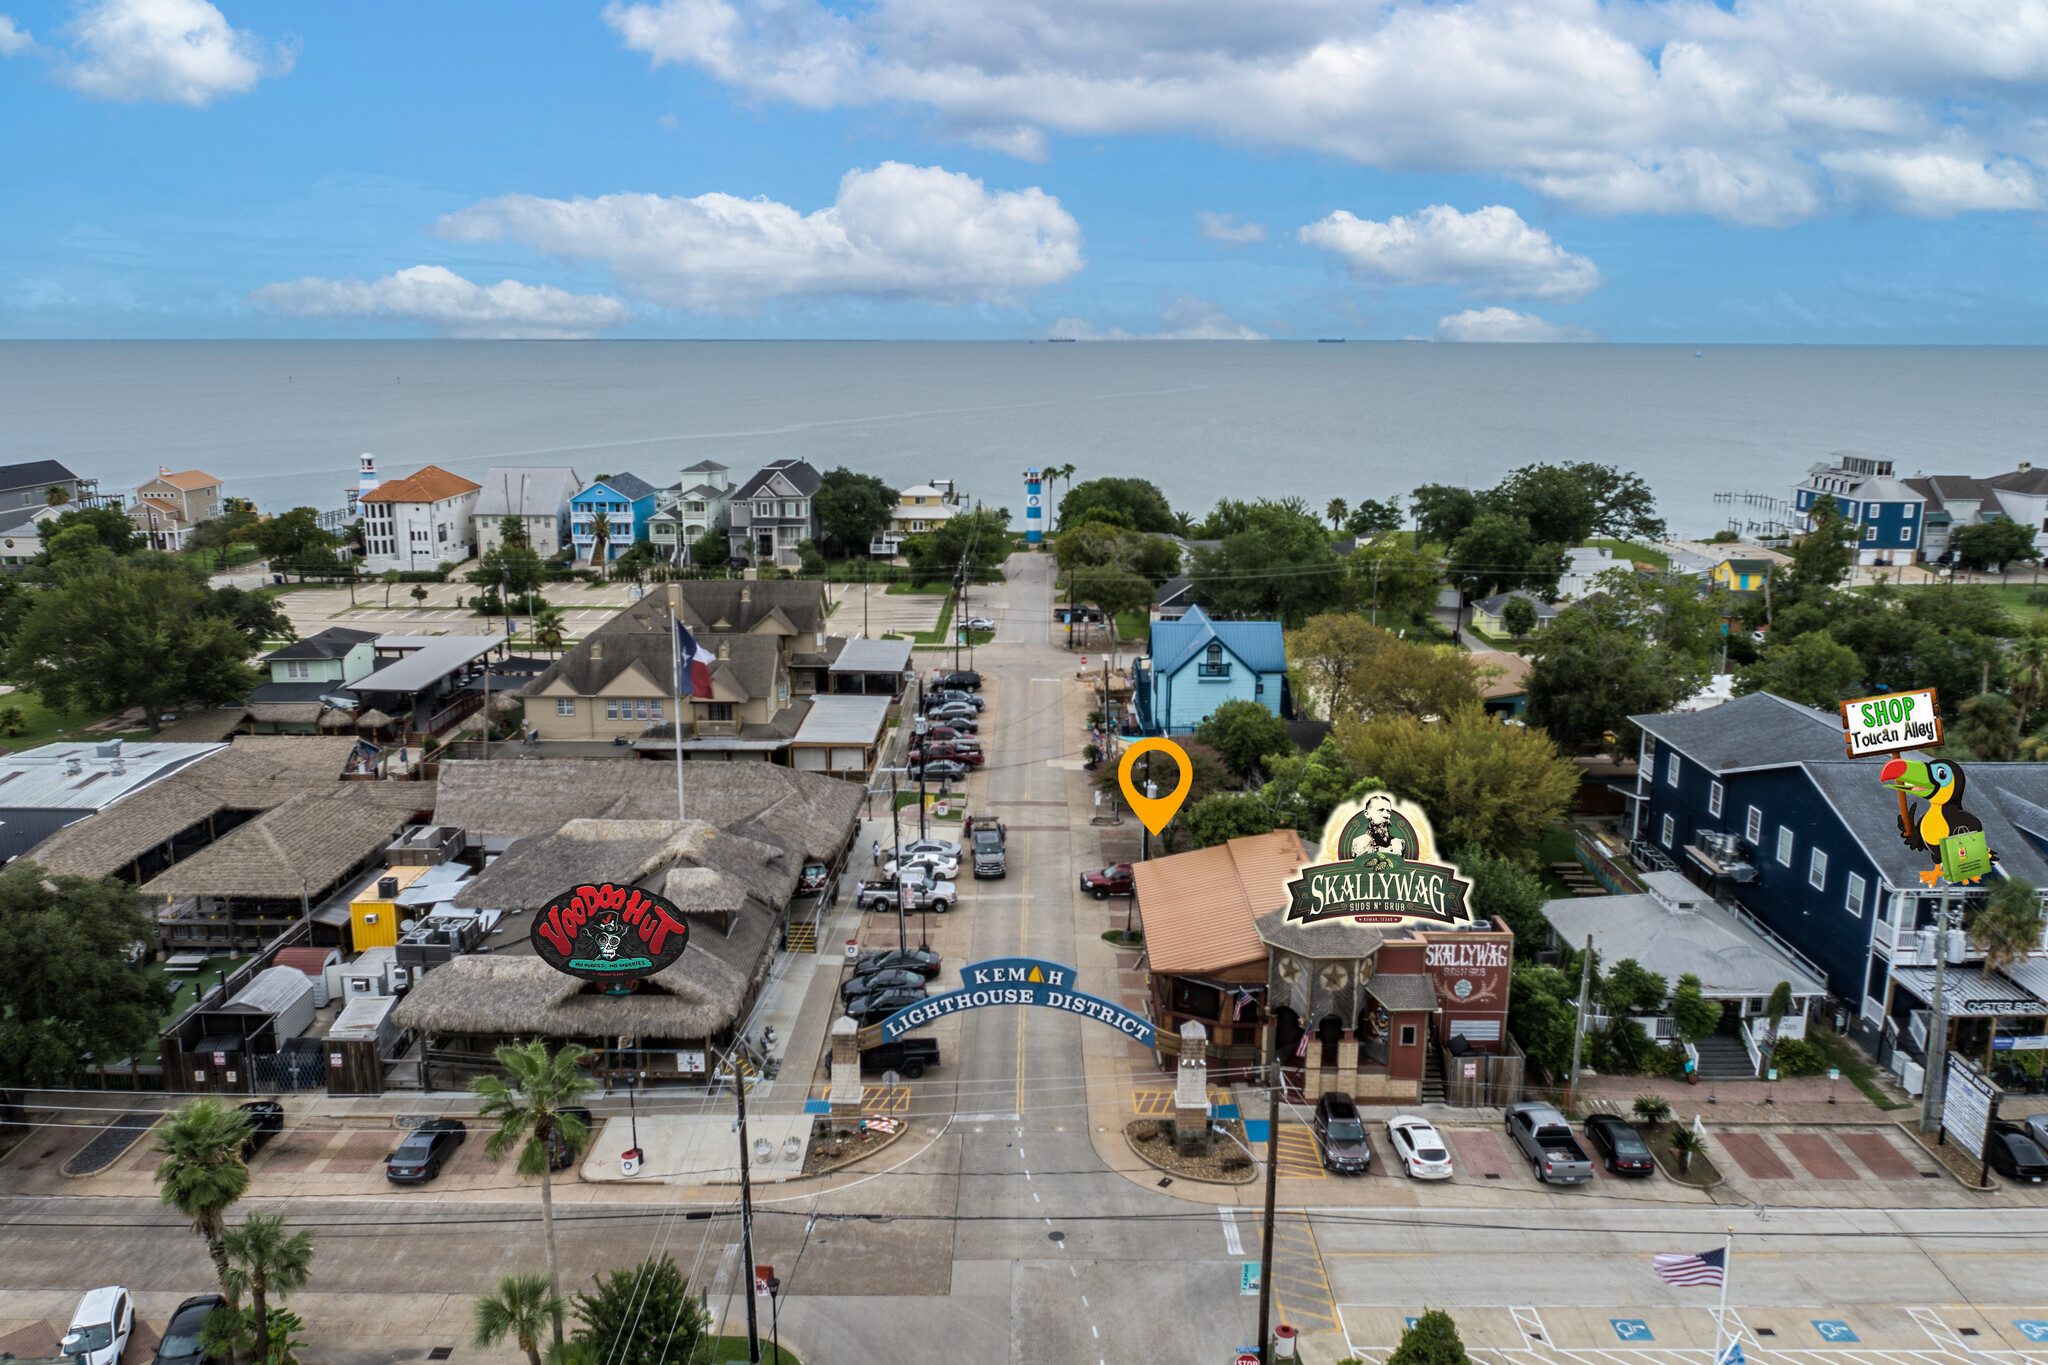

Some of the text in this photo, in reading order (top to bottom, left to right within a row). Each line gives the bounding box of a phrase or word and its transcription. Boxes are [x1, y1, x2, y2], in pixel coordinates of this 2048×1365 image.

[1425, 942, 1508, 967] SKALLYWAG
[886, 989, 1151, 1041] LIGHTHOUSE DISTRICT
[1967, 1001, 2039, 1011] OYSTER BAR
